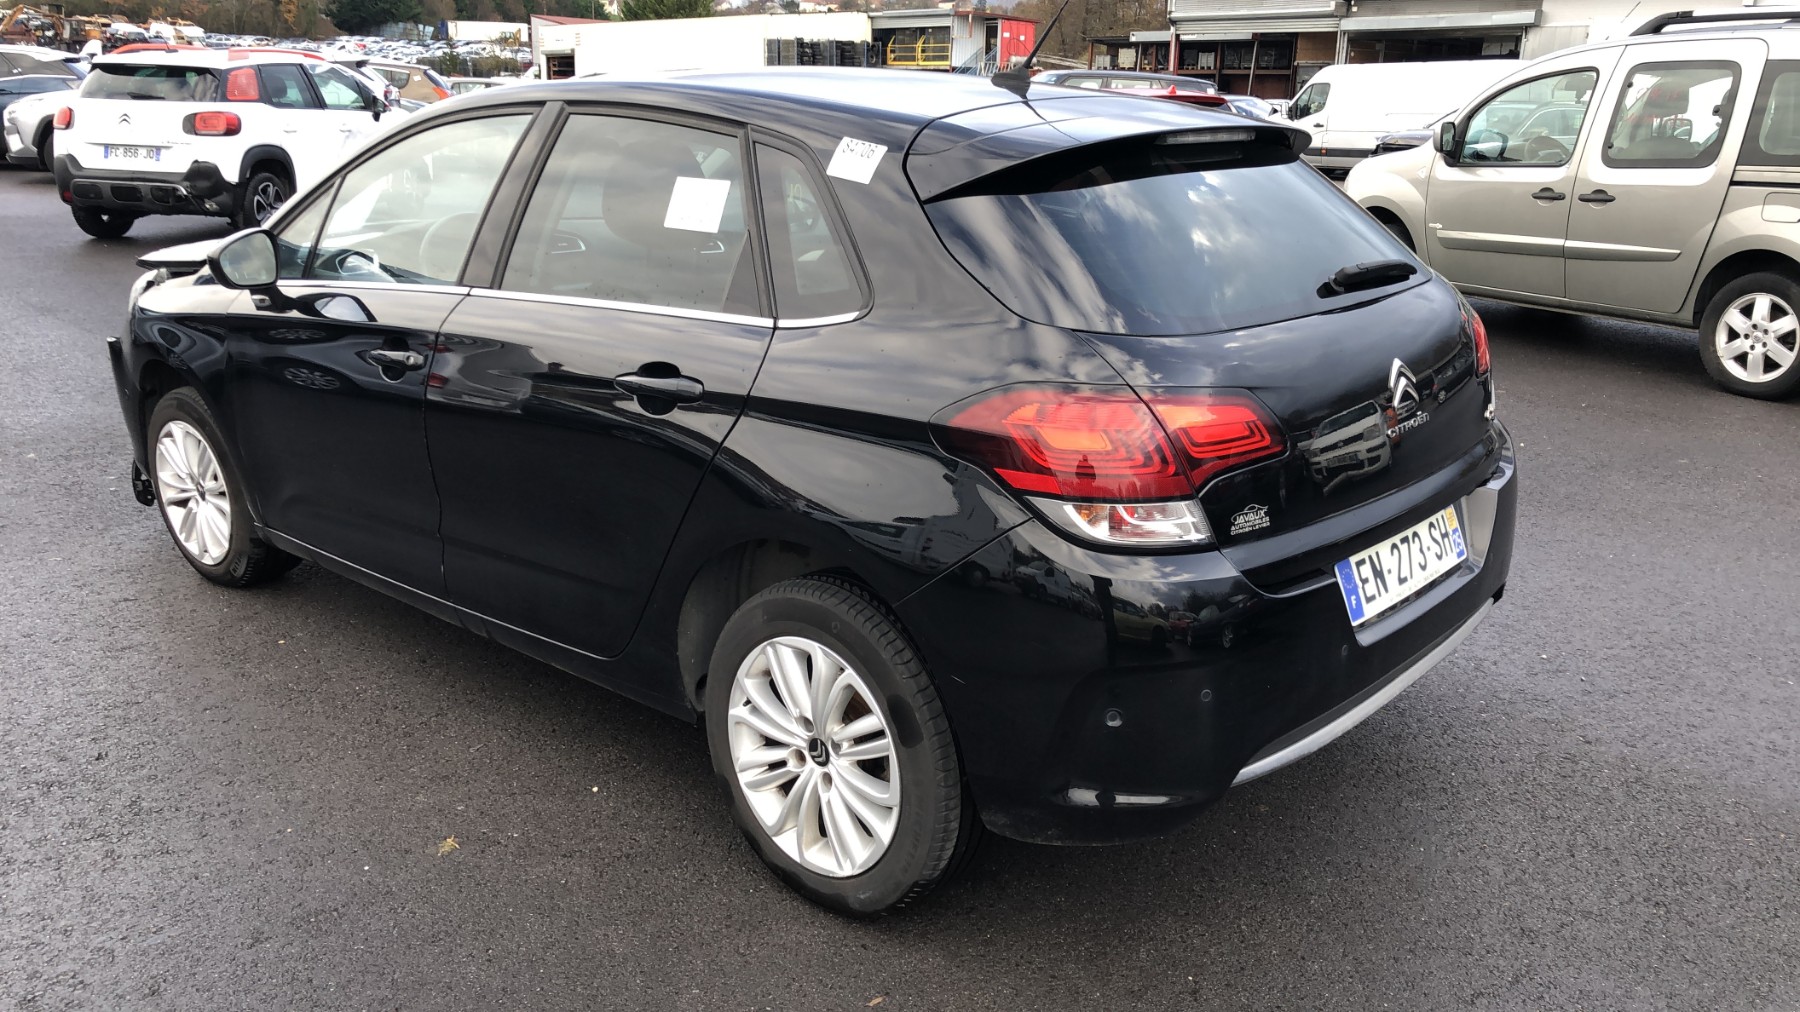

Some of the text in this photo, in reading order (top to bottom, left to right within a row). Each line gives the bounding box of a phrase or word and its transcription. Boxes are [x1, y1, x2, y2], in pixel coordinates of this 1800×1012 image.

[1230, 516, 1270, 531] AUTOMOBILES
[1234, 509, 1265, 524] JAVAUX
[1354, 513, 1454, 605] EN-273-SH
